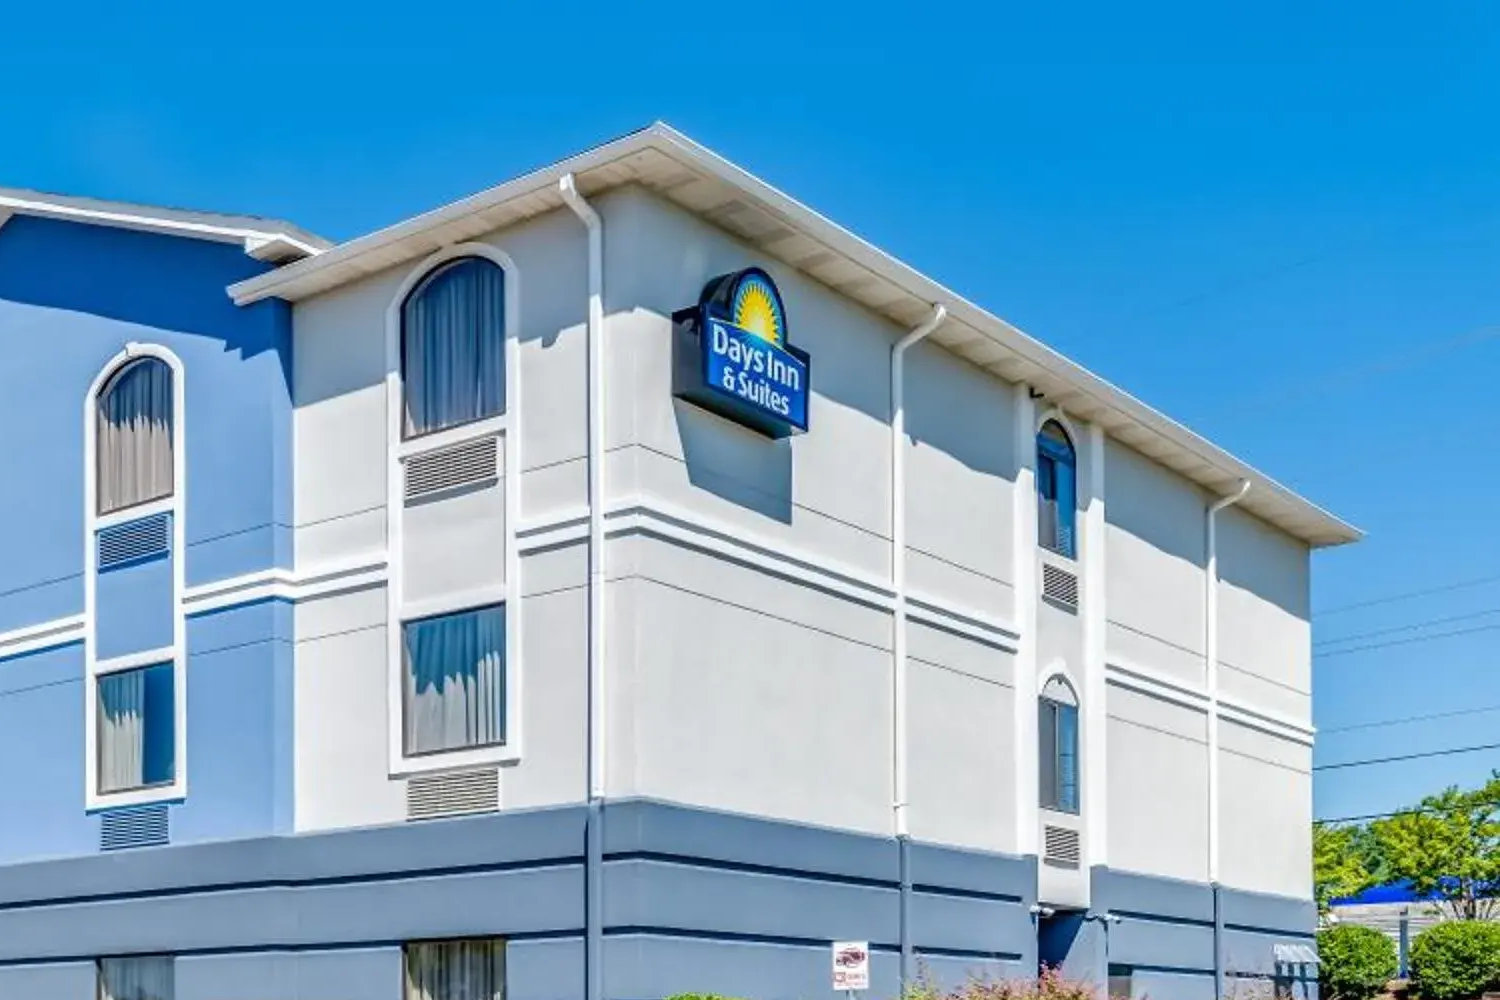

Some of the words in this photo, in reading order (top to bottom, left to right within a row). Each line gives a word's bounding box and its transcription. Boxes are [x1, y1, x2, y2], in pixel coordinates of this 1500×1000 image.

[713, 323, 764, 373] Days
[767, 351, 799, 391] Inn
[722, 366, 735, 391] &
[737, 371, 789, 415] Suites
